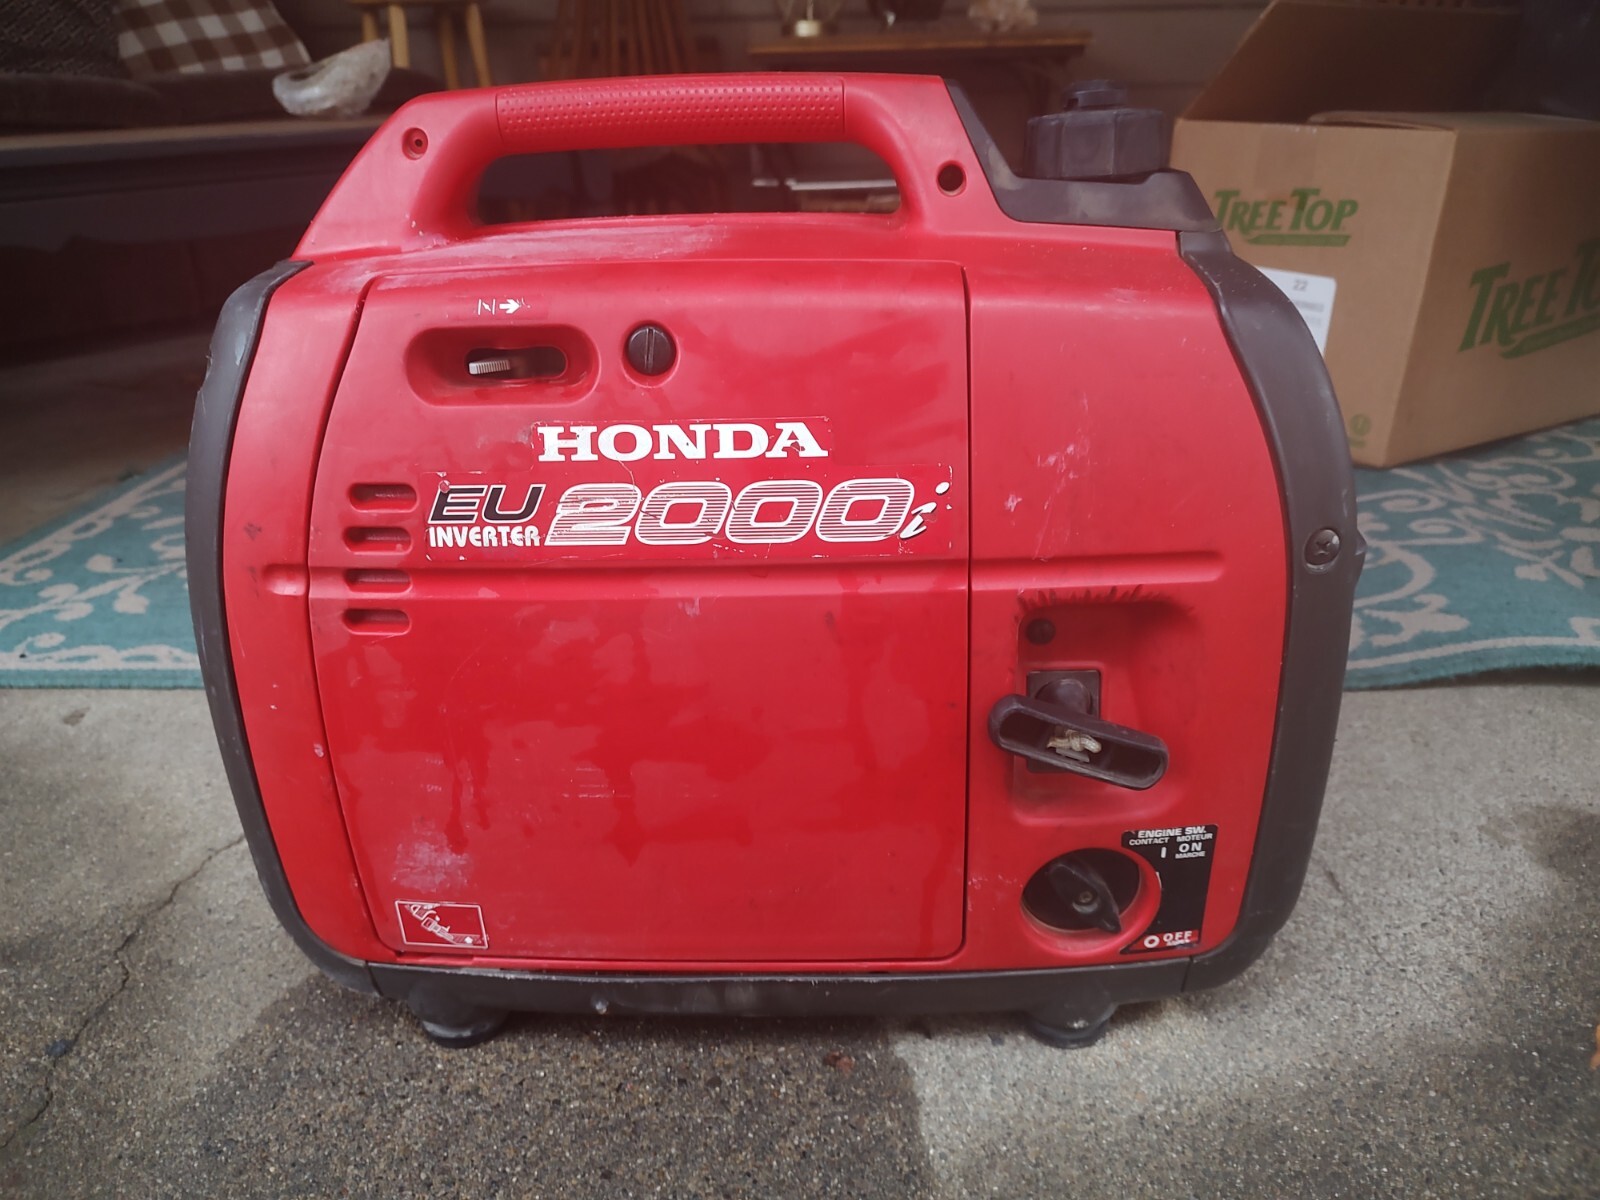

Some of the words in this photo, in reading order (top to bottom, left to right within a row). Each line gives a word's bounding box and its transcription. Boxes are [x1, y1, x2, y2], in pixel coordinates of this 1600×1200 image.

[1214, 189, 1288, 235] TREE
[1290, 188, 1360, 231] TOP
[1458, 261, 1569, 352] TREE
[537, 422, 829, 462] HONDA
[427, 483, 547, 524] EU
[428, 525, 541, 548] INVERTER
[1129, 837, 1169, 846] CONTACT
[1176, 833, 1213, 842] MOTEUR
[1137, 828, 1182, 838] ENGINE
[1184, 825, 1207, 835] SW.
[1178, 842, 1202, 853] ON
[1162, 930, 1192, 942] OFF
